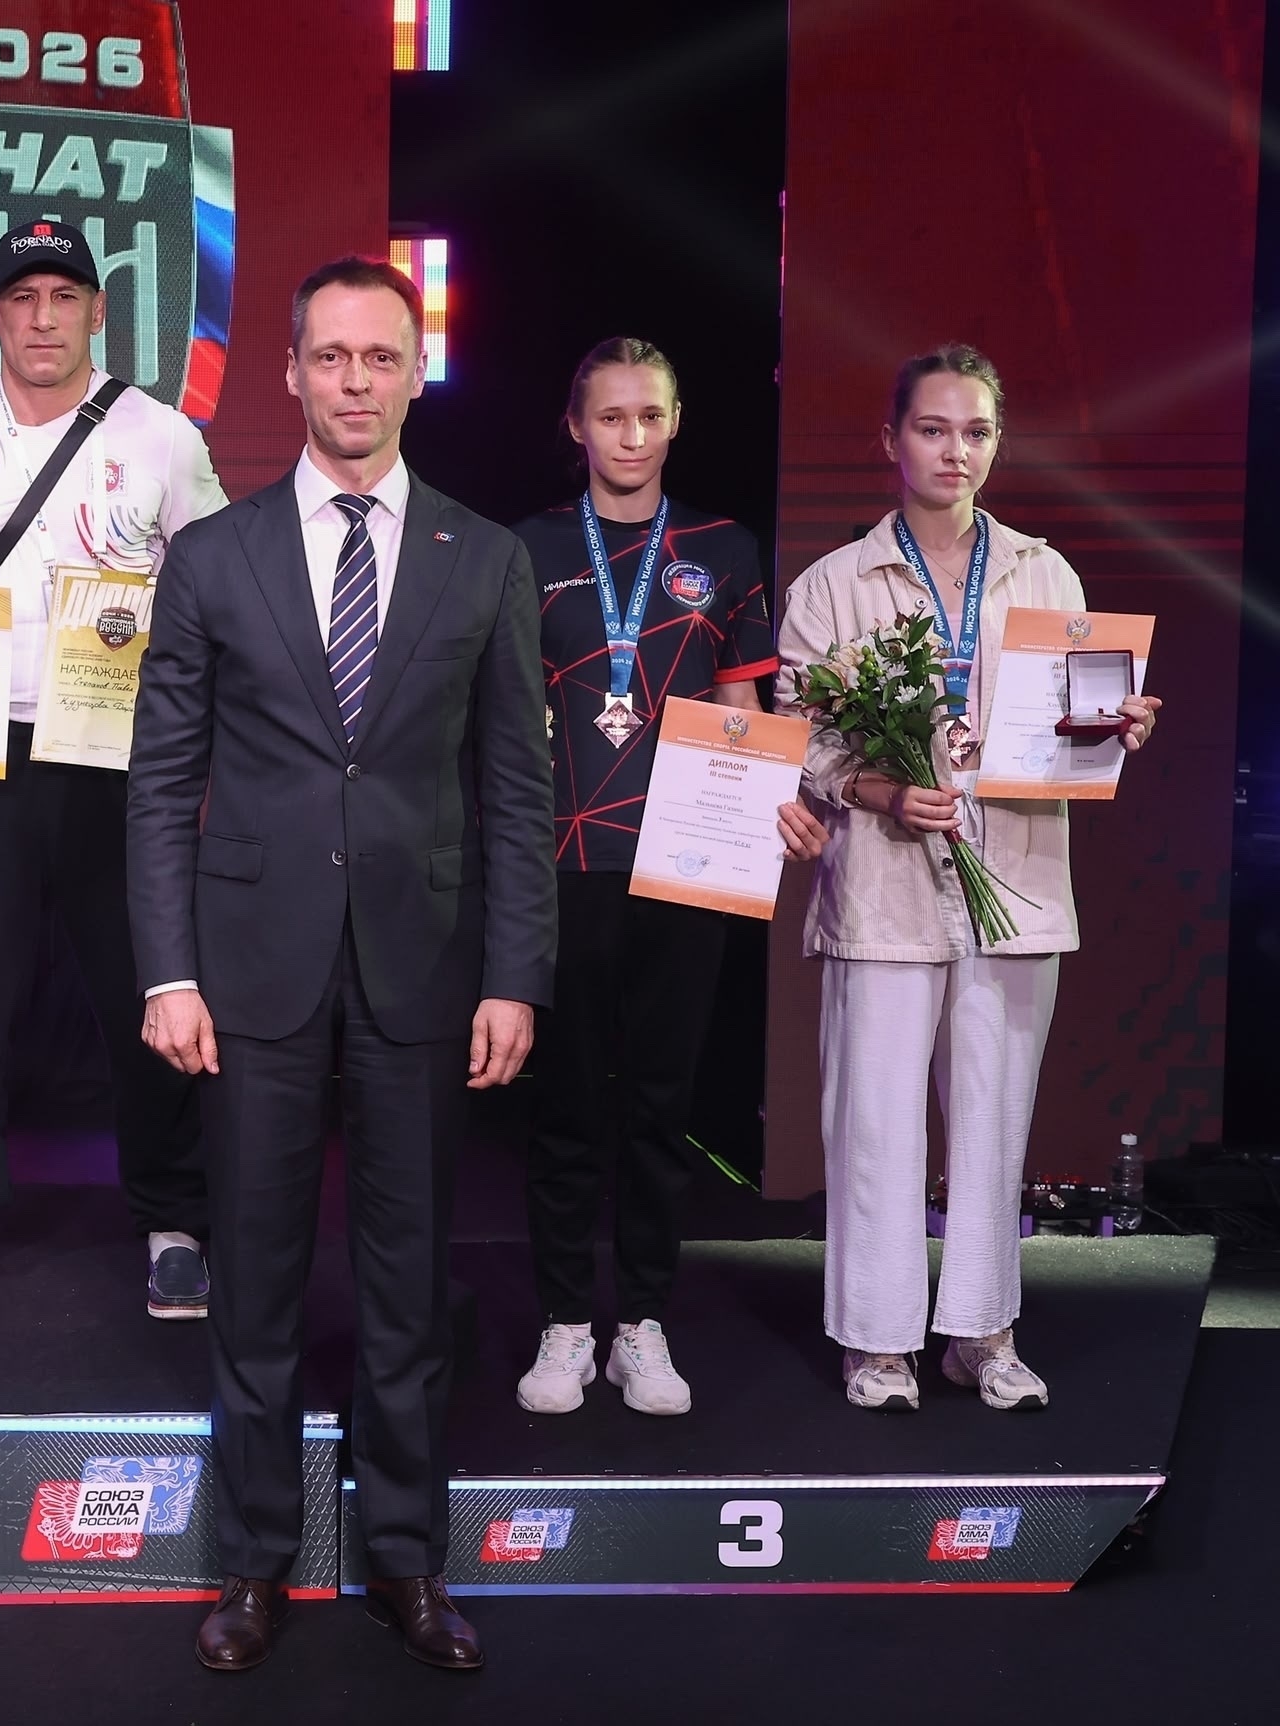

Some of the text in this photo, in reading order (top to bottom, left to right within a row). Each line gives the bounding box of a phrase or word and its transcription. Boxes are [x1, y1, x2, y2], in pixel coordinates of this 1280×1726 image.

[10, 234, 73, 254] TORNADO
[586, 517, 600, 550] СПОРТА
[642, 549, 657, 581] СПОРТА
[904, 541, 923, 571] СПОРТА
[593, 549, 615, 614] МИНИСТЕРСТВО
[968, 565, 983, 596] СПОРТА
[631, 580, 648, 617] РОССИИ
[964, 595, 977, 634] РОССИИ
[99, 620, 135, 636] РОССИИ
[60, 663, 137, 681] НАГРАЖДАЕ
[708, 758, 749, 773] ДИПЛОМ
[717, 772, 743, 782] степени
[85, 1490, 145, 1502] СОЮЗ
[81, 1502, 140, 1516] ММА
[78, 1517, 139, 1526] РОССИИ
[510, 1532, 542, 1540] ММА
[716, 1499, 785, 1568] 3
